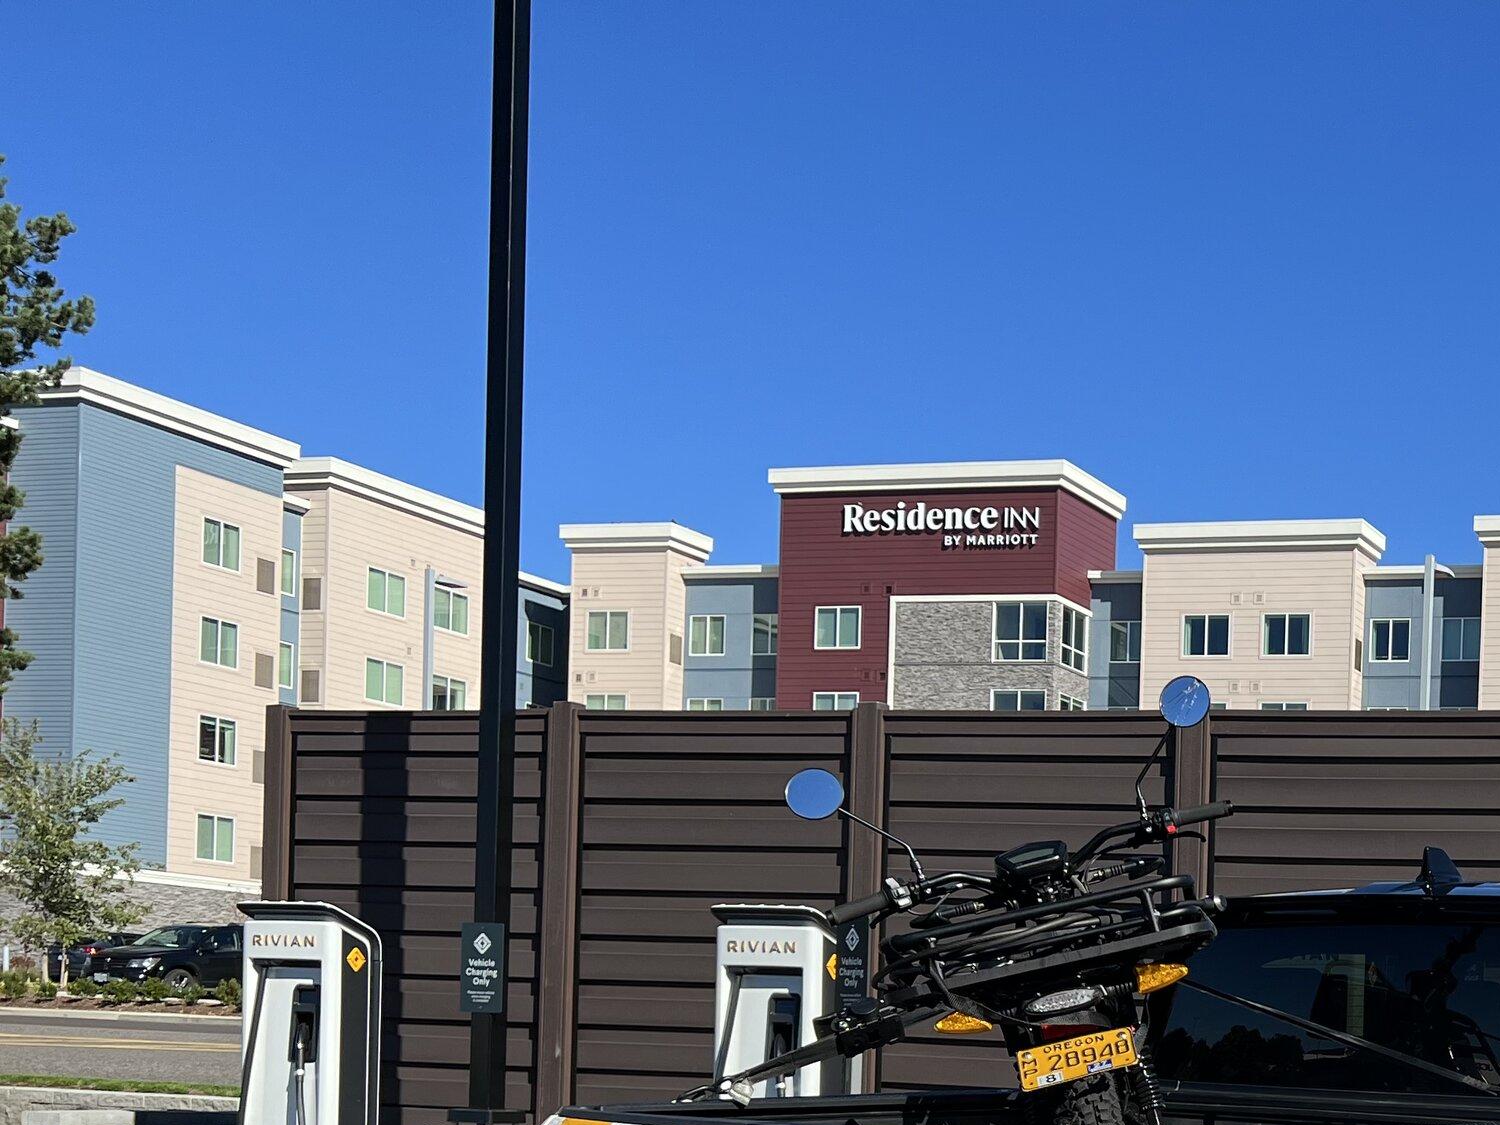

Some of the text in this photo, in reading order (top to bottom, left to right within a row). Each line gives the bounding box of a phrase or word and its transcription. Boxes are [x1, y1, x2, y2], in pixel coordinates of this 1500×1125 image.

[843, 501, 1040, 532] Residence INN
[944, 534, 1040, 546] BY MARRIOTT
[252, 934, 315, 947] RIVIAN
[727, 940, 796, 953] RIVIAN
[468, 958, 496, 967] Vehicle
[841, 957, 863, 966] Vehicle
[465, 967, 498, 978] Charging
[839, 968, 864, 978] Charging
[472, 977, 490, 987] Only
[844, 977, 859, 988] Only
[1043, 1034, 1105, 1054] OREGON
[1046, 1072, 1057, 1083] 8
